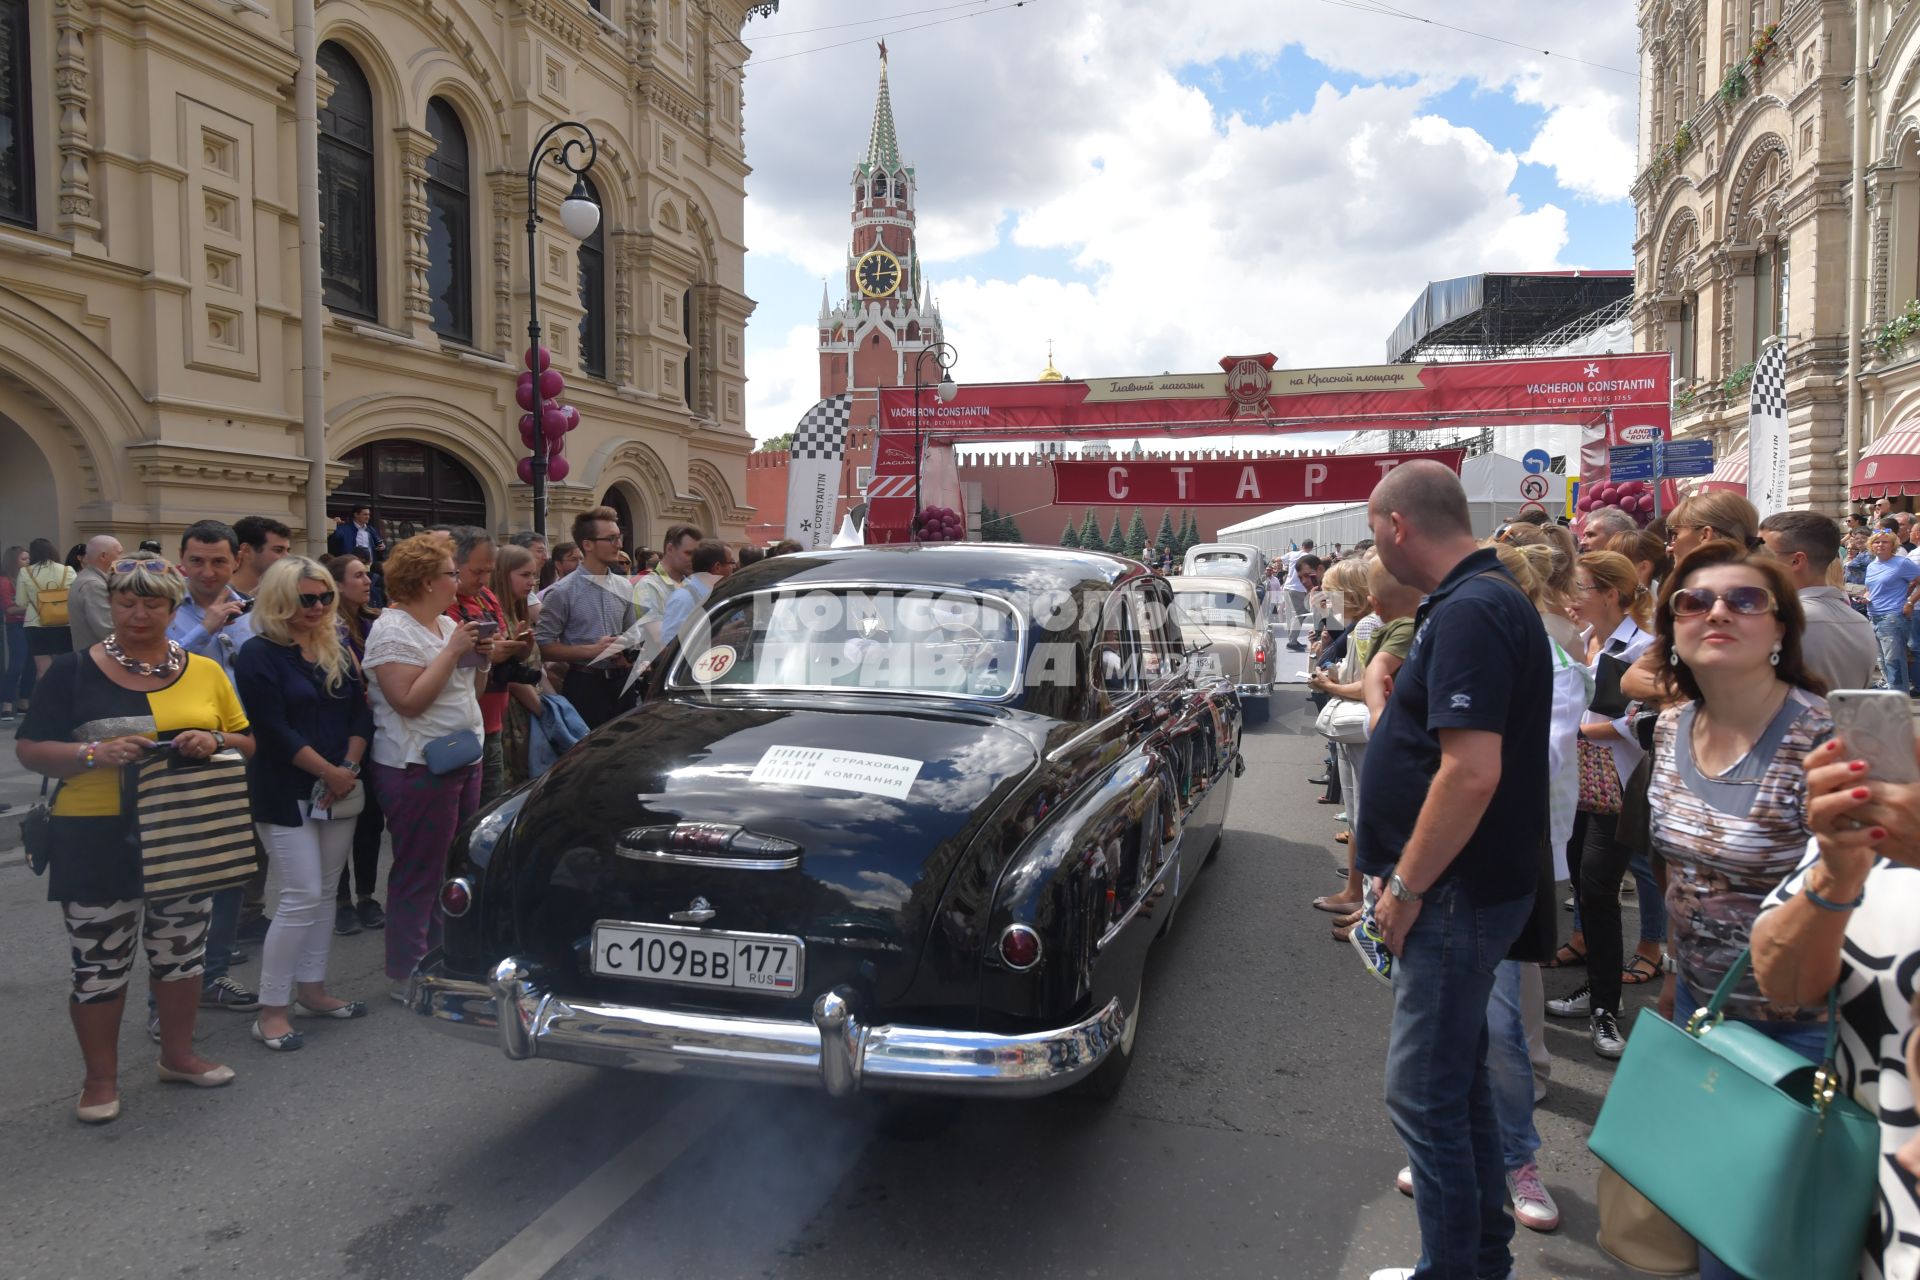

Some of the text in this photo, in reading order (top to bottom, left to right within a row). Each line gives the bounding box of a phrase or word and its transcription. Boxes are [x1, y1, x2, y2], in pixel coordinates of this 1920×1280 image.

[1110, 381, 1205, 392] Главный магазин
[1289, 373, 1405, 387] на Красной площади
[1526, 378, 1656, 395] VACHERON CONSTANTIN
[937, 406, 990, 417] CONSTANTIN
[814, 473, 827, 529] CONSTANTIN
[768, 758, 817, 768] ПАРИ
[832, 756, 910, 773] СТРАХОВАЯ
[823, 770, 904, 787] КОМПАНИЯ
[738, 944, 789, 974] 177
[749, 973, 774, 985] RUS
